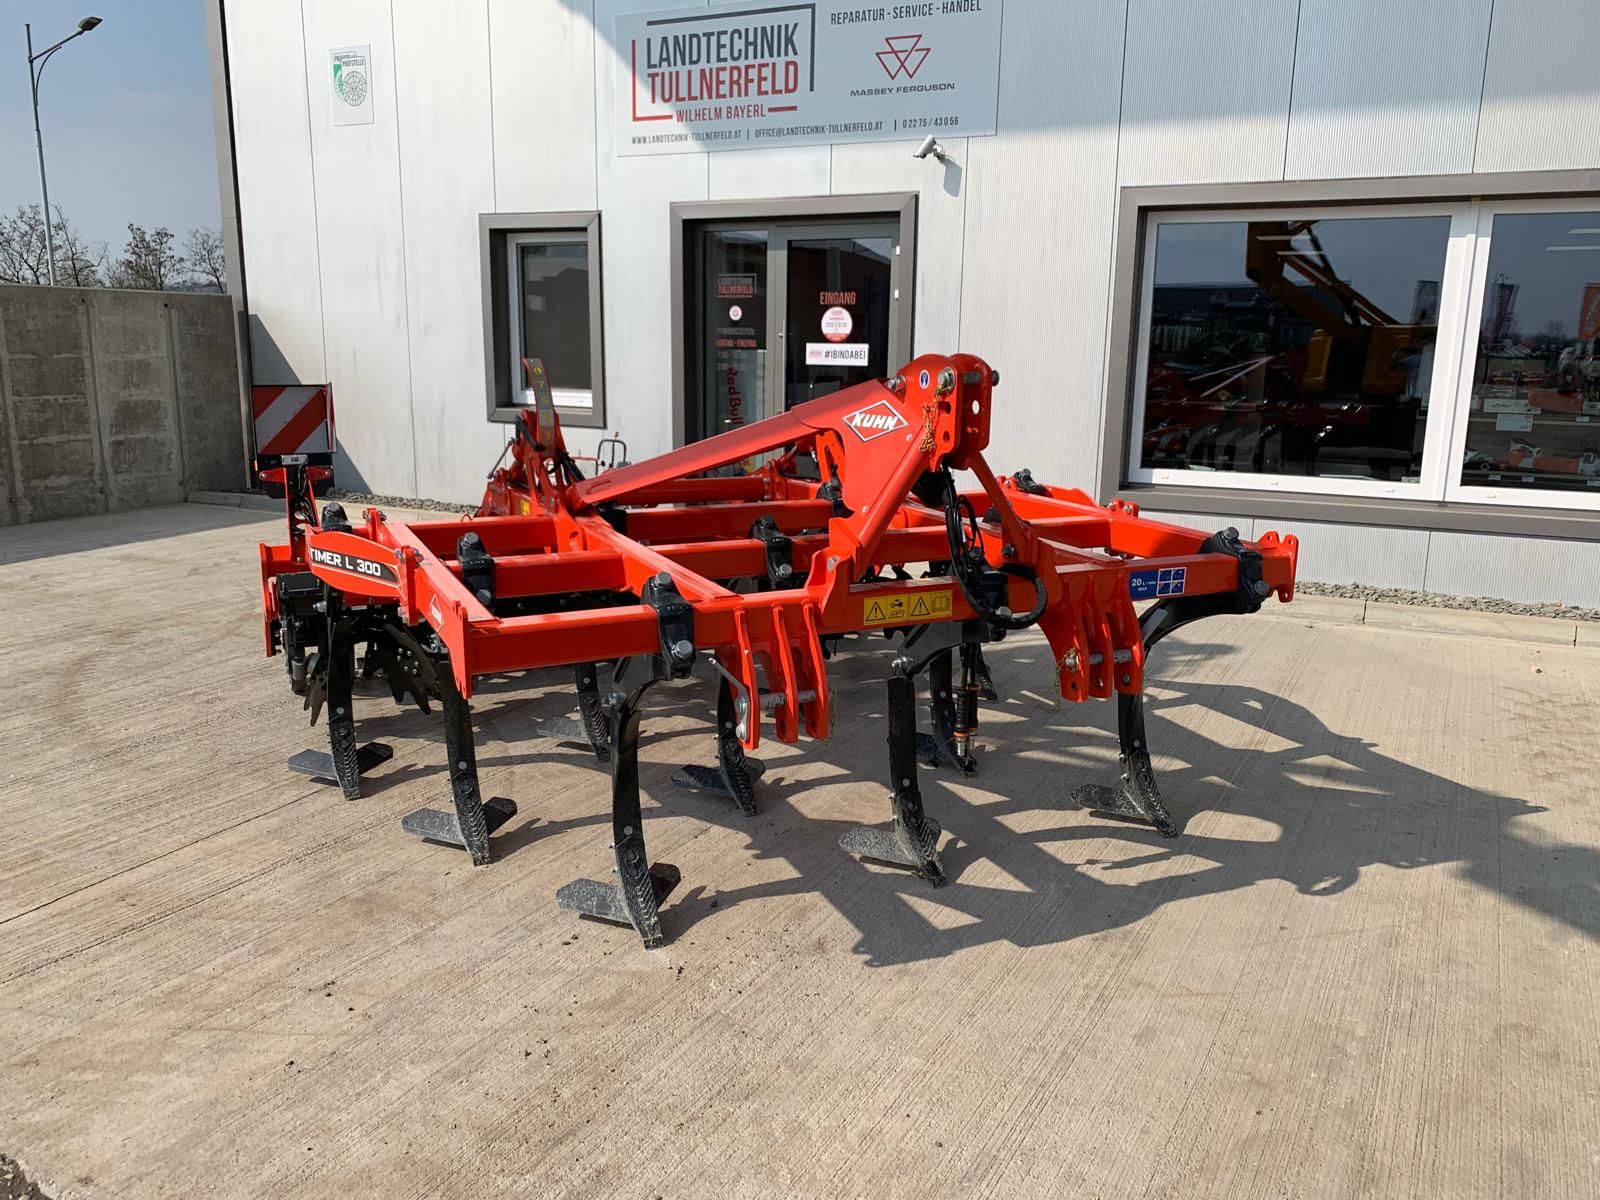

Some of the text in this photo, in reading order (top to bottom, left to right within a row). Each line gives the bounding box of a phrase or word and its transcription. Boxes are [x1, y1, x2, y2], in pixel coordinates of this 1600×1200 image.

[831, 8, 885, 25] REPARATUR
[893, 3, 934, 19] SERVICE
[942, 0, 982, 14] HANDEL
[646, 23, 799, 69] LANDTECHNIK
[647, 60, 799, 104] TULLNERFELD
[850, 83, 955, 97] MASSEY FERGUSON
[676, 104, 766, 122] WILHELM BAYERL
[632, 129, 742, 145] WWW.LANDTECHNIK-TULLNERFELD.AT
[754, 121, 883, 138] OFFICE@LANDTECHNIK-TULLNERFELD.AT
[819, 291, 857, 305] EINGANG
[824, 350, 866, 360] #IBINDABEI
[851, 413, 899, 430] KUHN
[310, 548, 381, 577] TIMER L 300
[1131, 578, 1142, 587] 20
